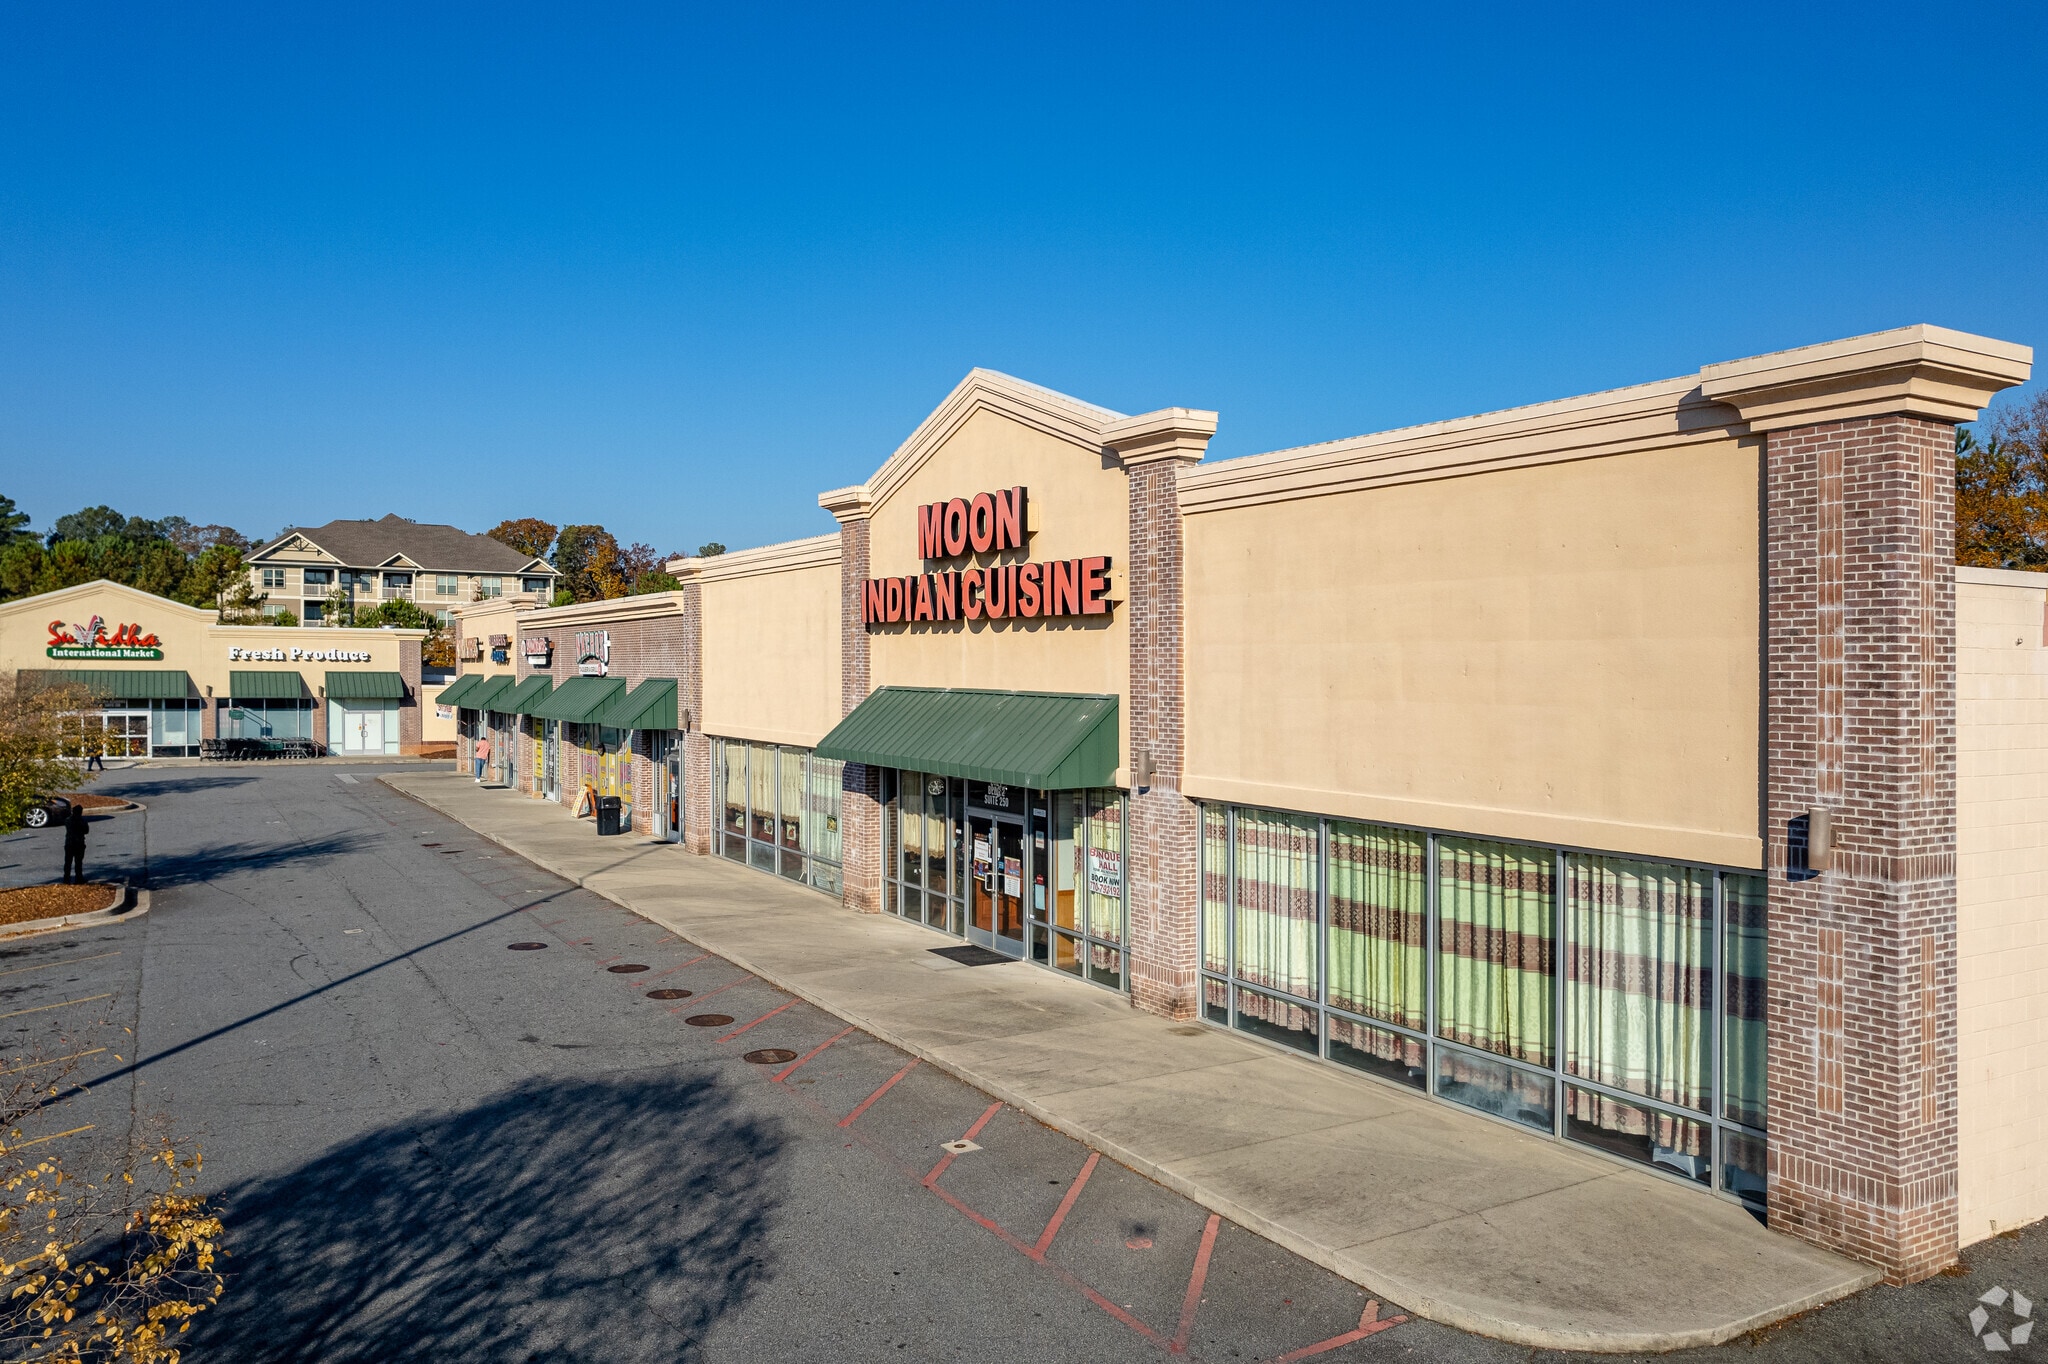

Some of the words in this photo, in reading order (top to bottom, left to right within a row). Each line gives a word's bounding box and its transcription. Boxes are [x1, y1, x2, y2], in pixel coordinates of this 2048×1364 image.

[918, 486, 1025, 560] MOON
[861, 571, 961, 623] INDIAN
[962, 556, 1111, 620] CUISINE
[52, 649, 121, 658] International
[123, 650, 154, 658] Market
[228, 646, 284, 660] Fresh
[289, 647, 369, 661] Produce
[984, 794, 998, 806] SUITE
[1090, 848, 1120, 862] BANQUE
[1099, 861, 1118, 872] HALL
[1091, 873, 1108, 884] BOOK
